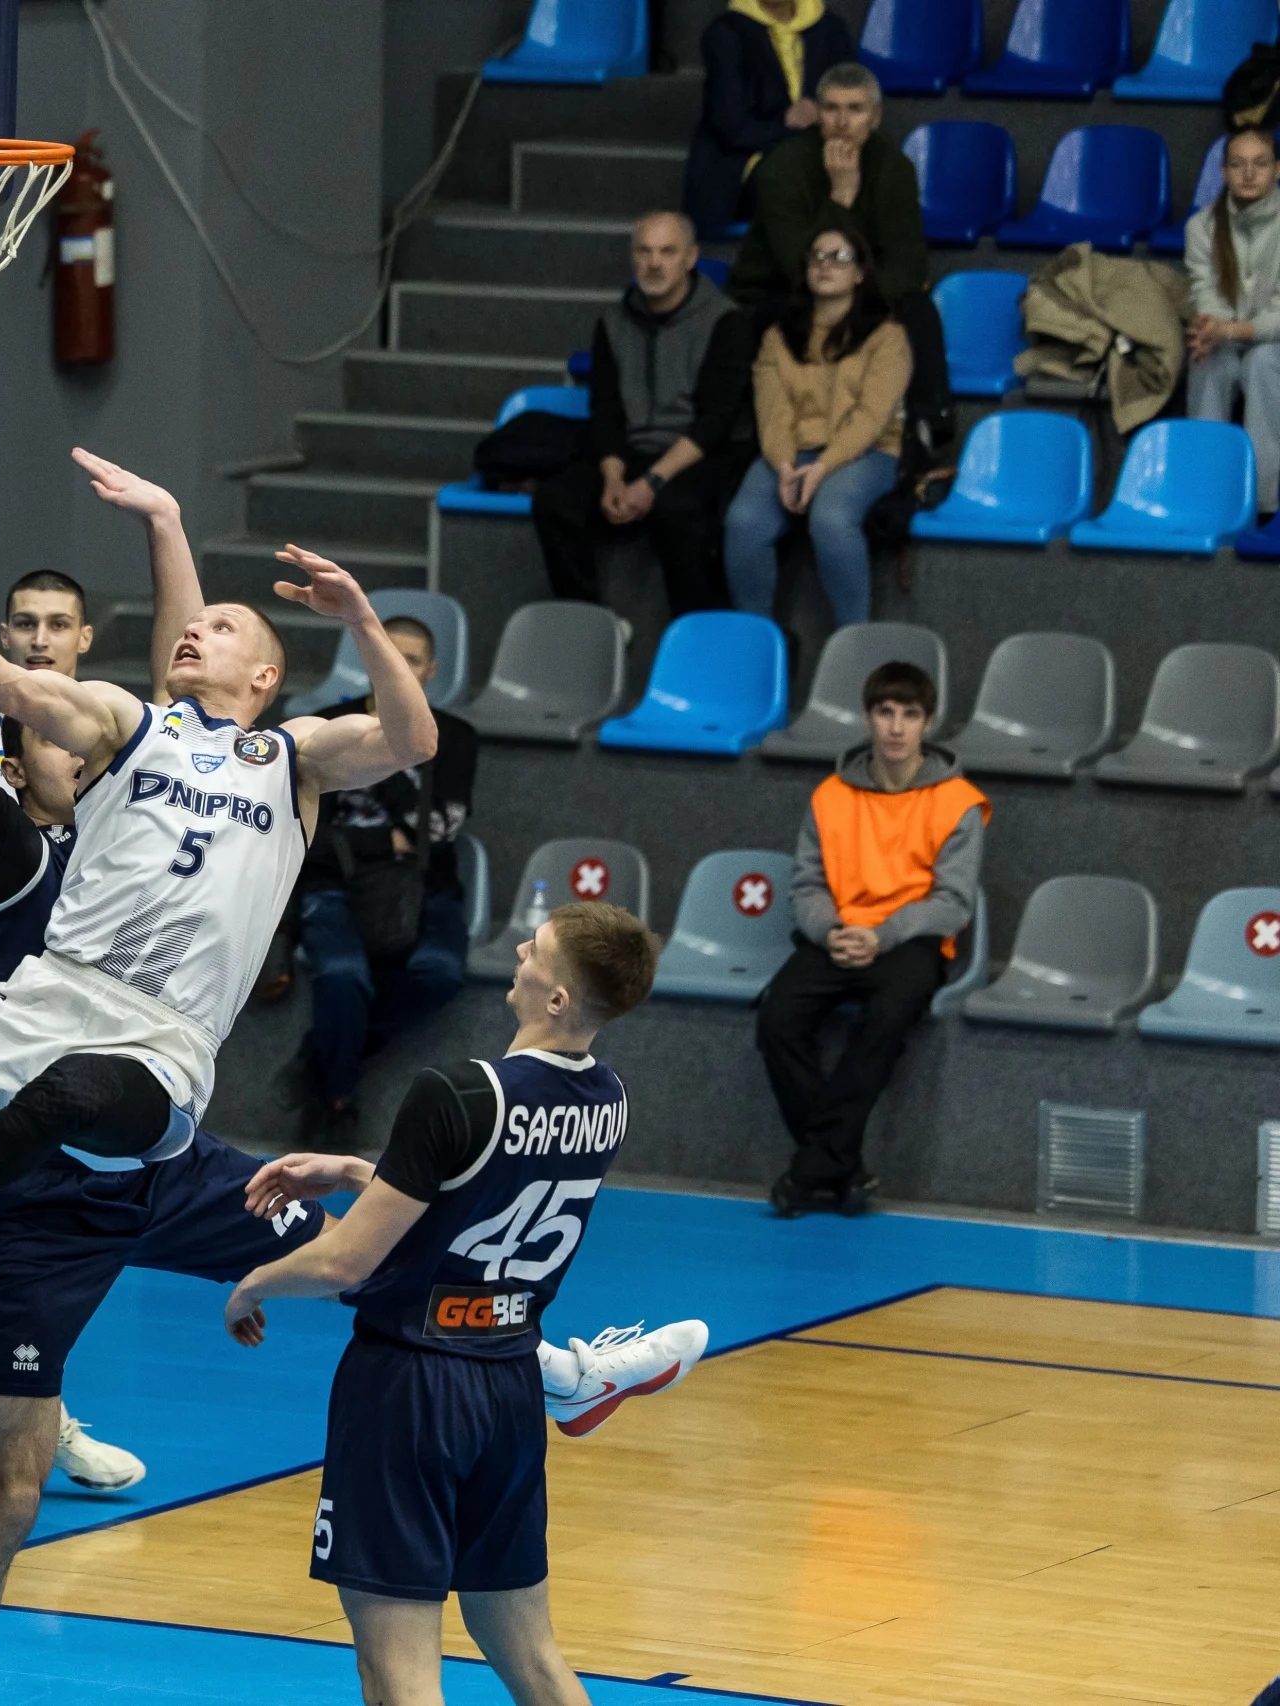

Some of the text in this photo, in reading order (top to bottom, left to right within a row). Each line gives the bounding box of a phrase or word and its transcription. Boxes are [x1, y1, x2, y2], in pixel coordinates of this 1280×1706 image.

[126, 769, 274, 835] DNIPRO
[168, 827, 215, 878] 5
[504, 1101, 623, 1156] SAFONOV
[448, 1178, 602, 1282] 45
